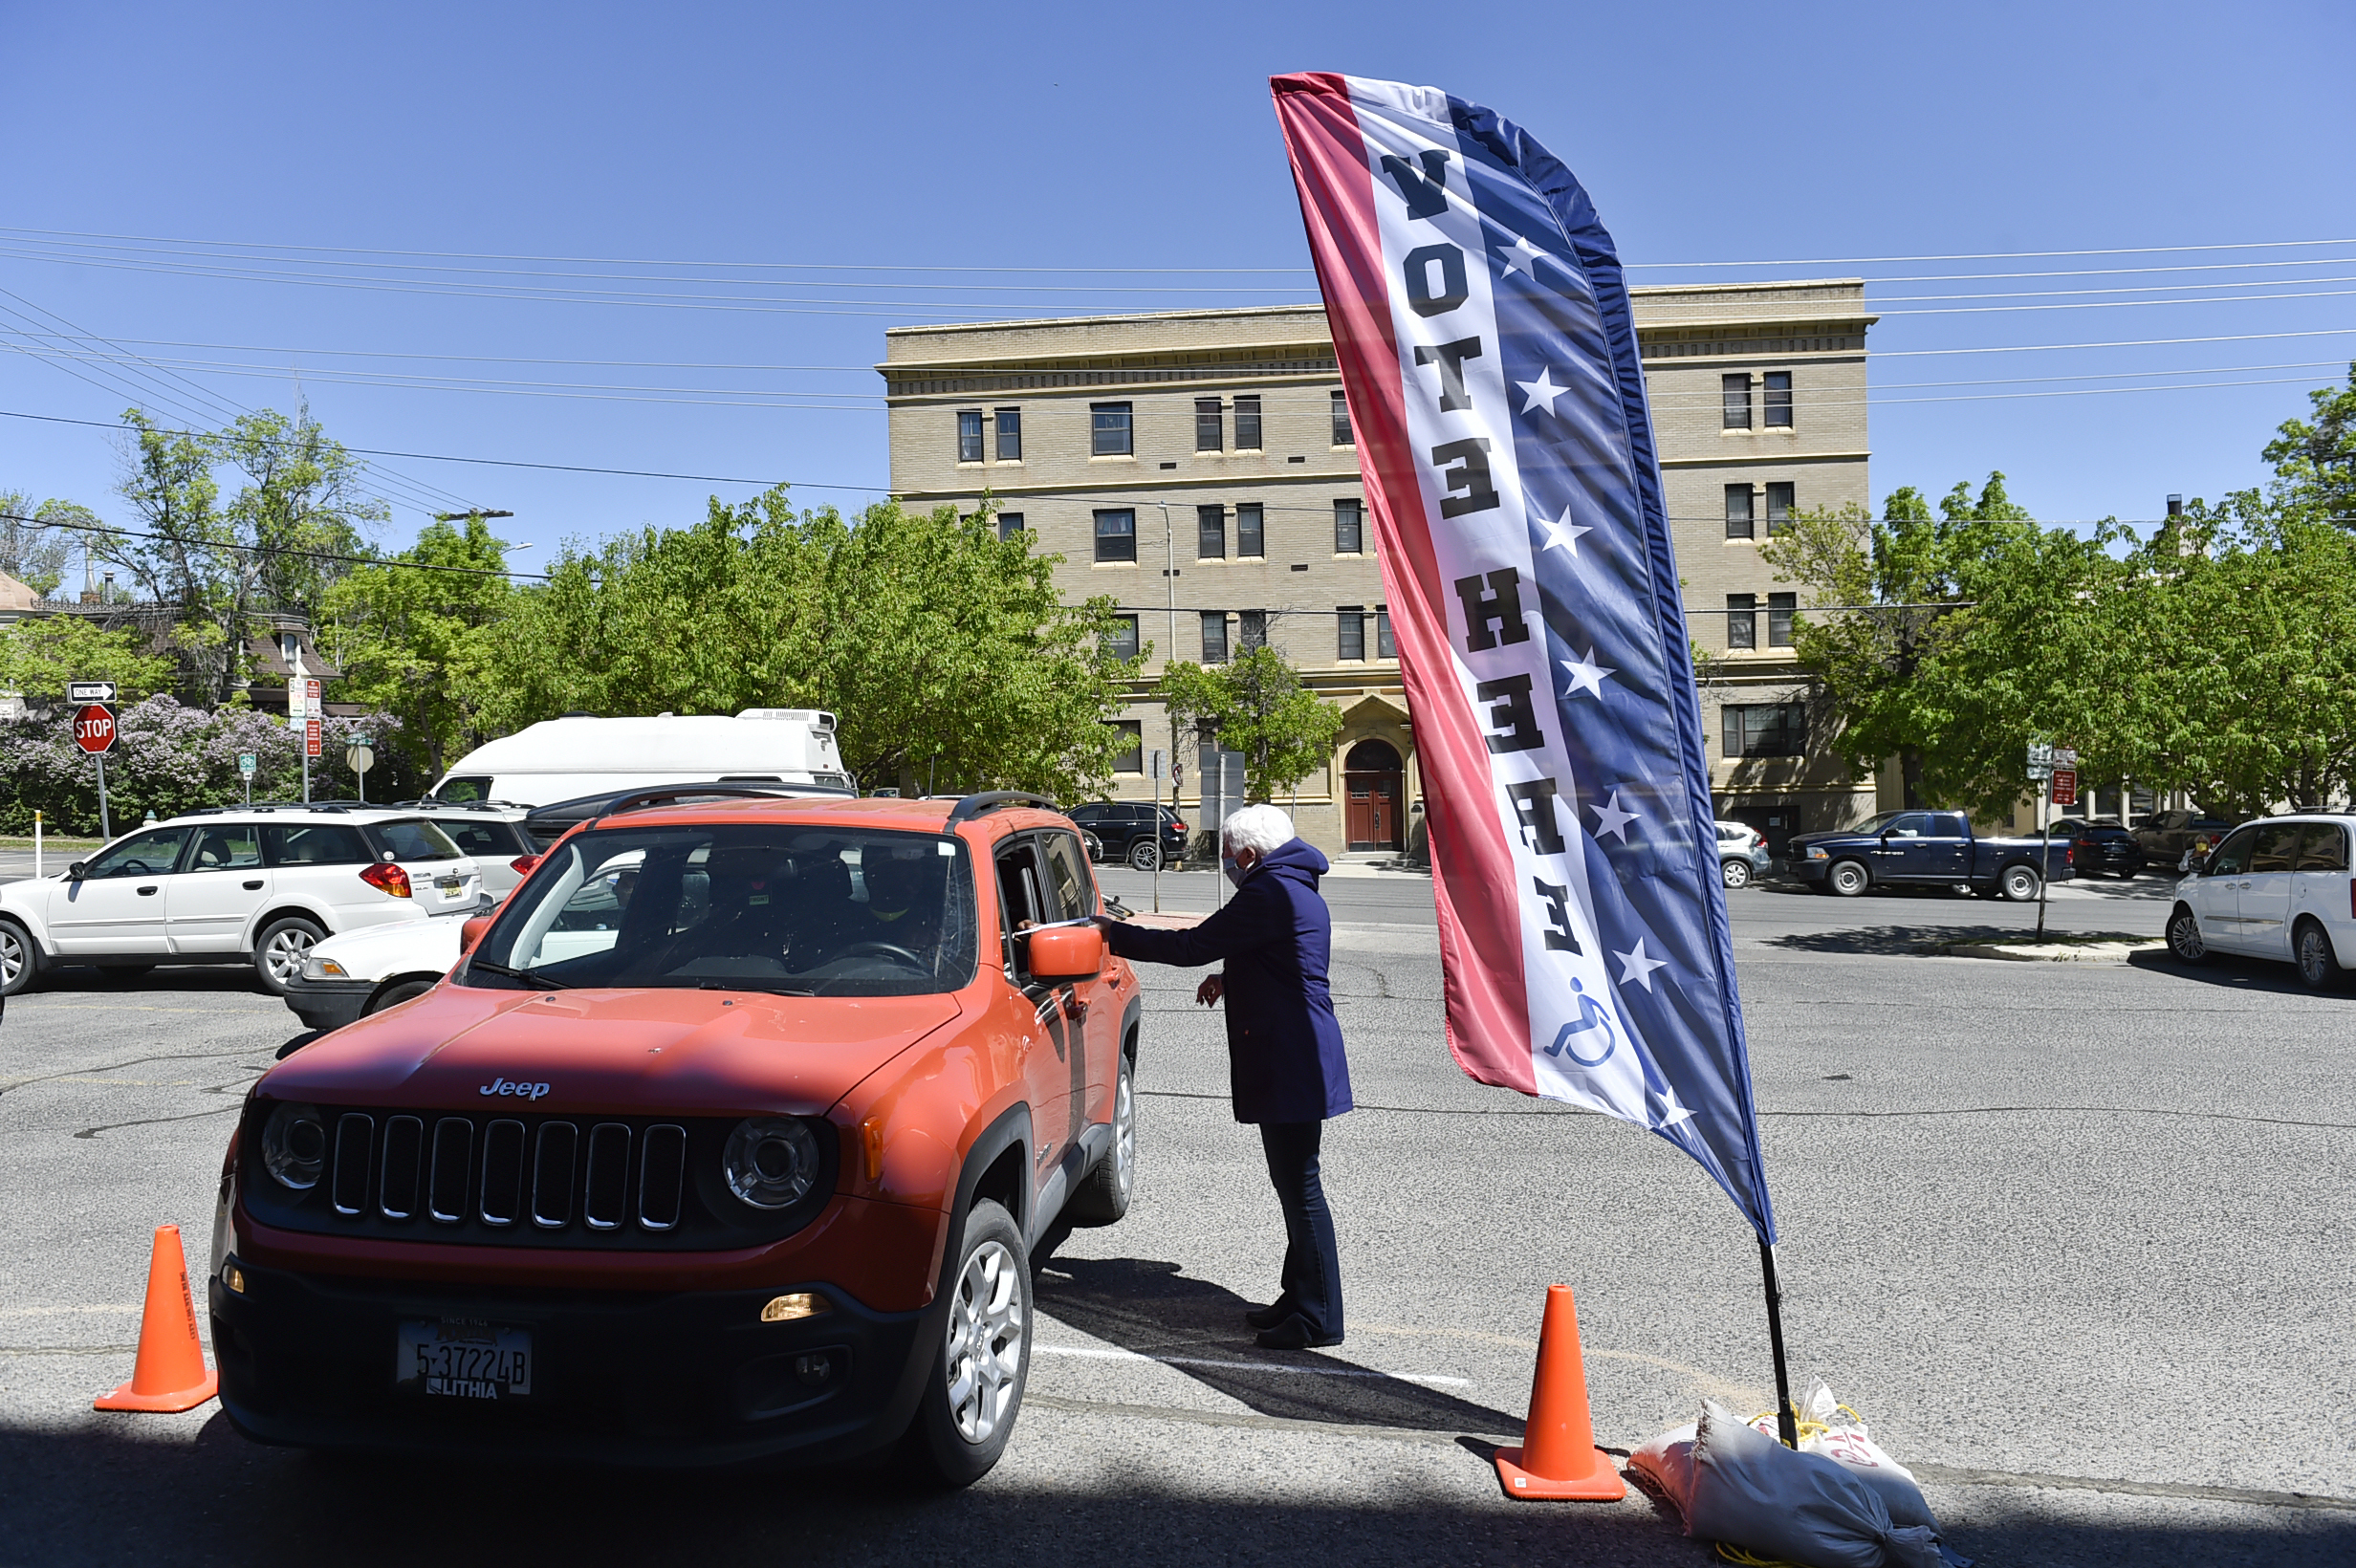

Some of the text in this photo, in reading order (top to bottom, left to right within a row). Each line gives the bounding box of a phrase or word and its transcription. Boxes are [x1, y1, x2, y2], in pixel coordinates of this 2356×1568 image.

[76, 718, 112, 739] STOP
[479, 1078, 551, 1101] Jeep
[440, 1317, 489, 1328] SINCE 1946
[443, 1379, 498, 1400] LITHIA
